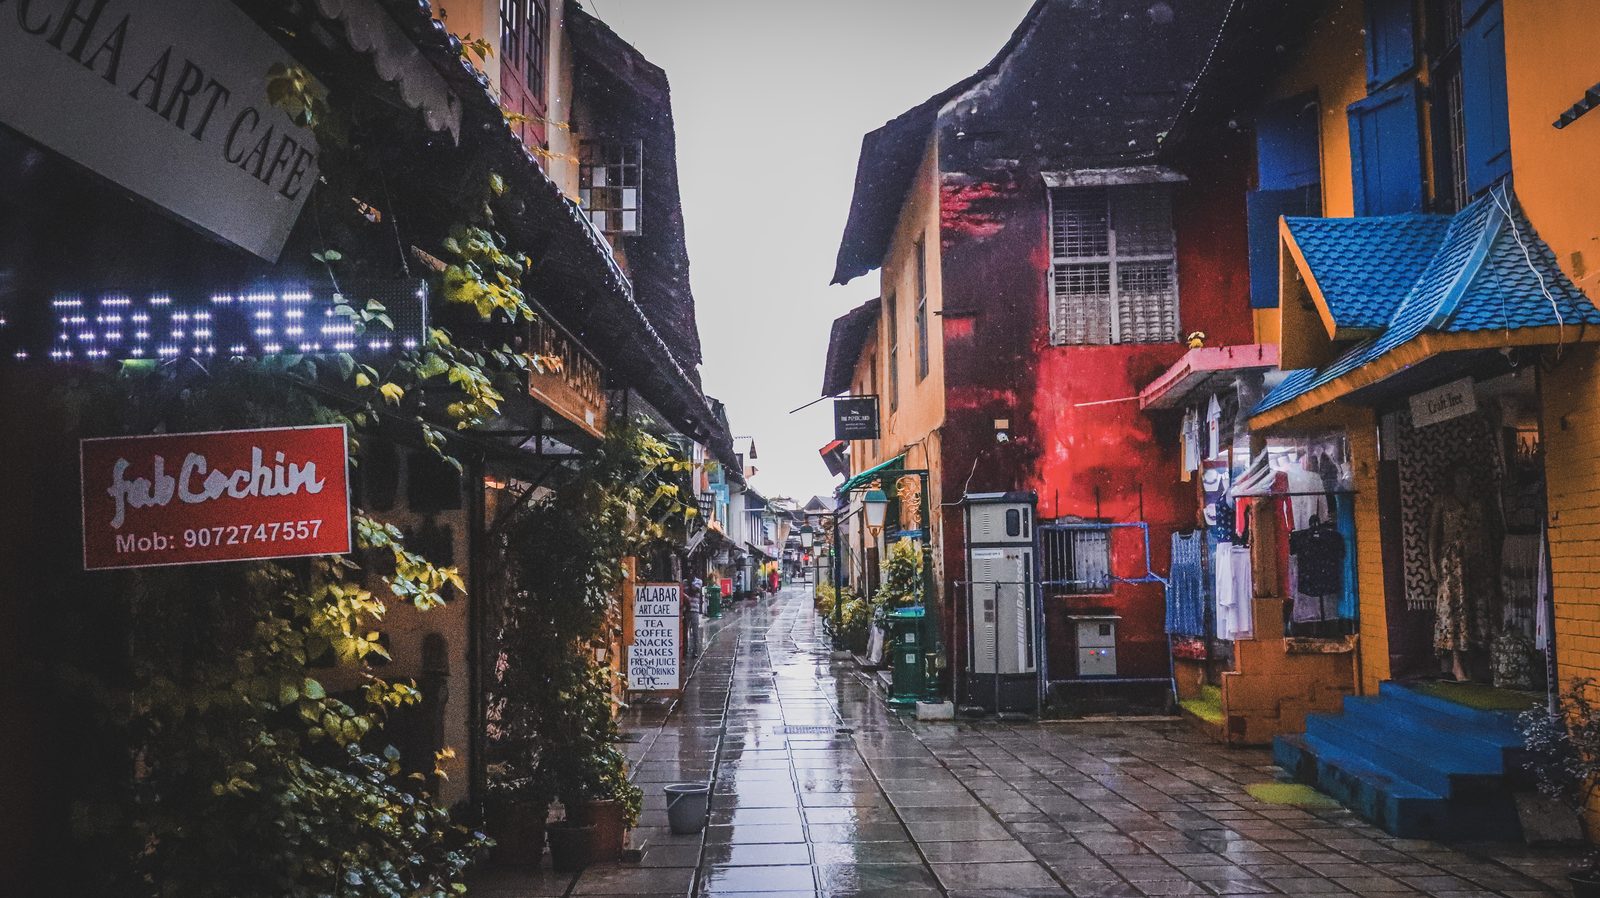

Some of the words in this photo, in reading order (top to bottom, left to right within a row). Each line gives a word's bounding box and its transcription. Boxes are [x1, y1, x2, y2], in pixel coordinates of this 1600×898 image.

[128, 45, 231, 141] ART
[223, 106, 313, 200] CAFE
[115, 531, 175, 553] Mob:
[183, 519, 322, 548] 9072747557
[639, 605, 651, 615] ART
[653, 605, 670, 615] CAFE
[634, 629, 673, 637] COFFEE
[634, 639, 673, 647] SNACKS
[630, 658, 654, 666] FRESH
[656, 658, 676, 667] JUICE
[631, 668, 650, 676] COOL
[651, 668, 675, 676] DRINKS
